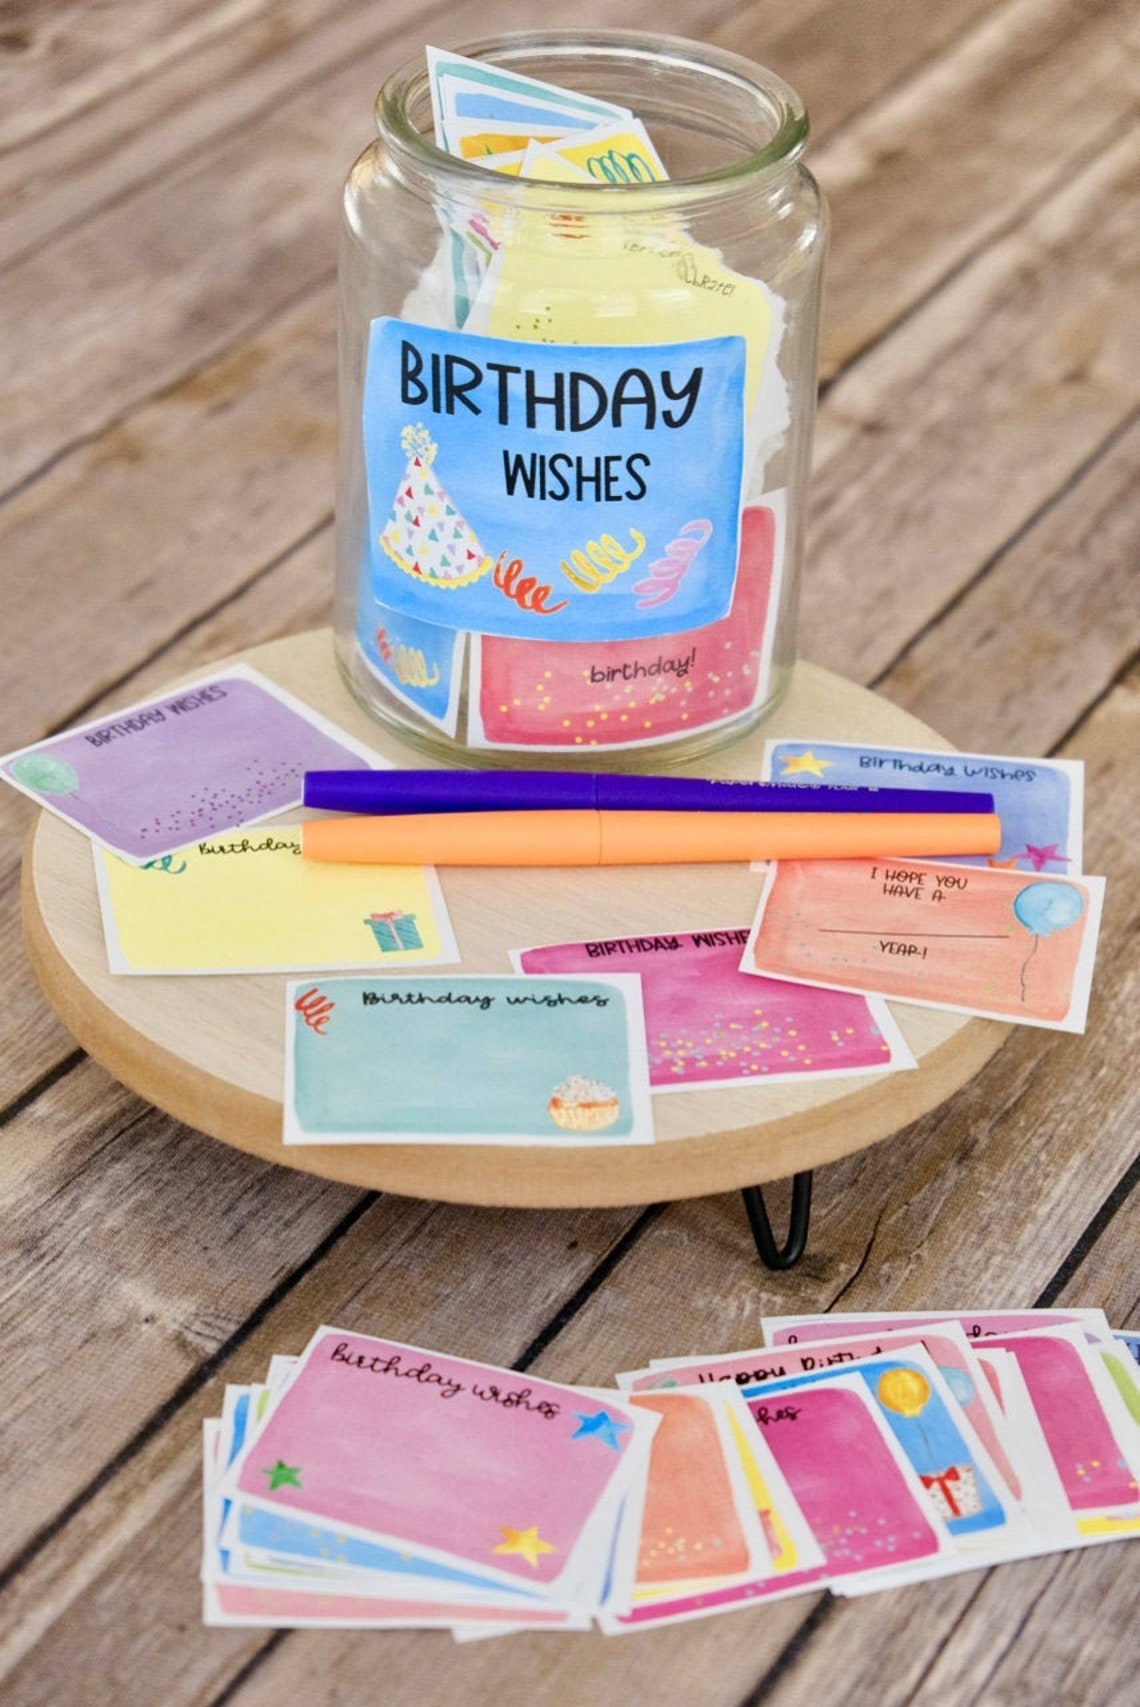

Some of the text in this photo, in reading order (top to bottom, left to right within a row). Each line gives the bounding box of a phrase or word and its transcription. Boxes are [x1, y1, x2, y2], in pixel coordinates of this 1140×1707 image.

[401, 339, 703, 432] BIRTHDAY
[502, 449, 651, 502] WISHES
[590, 646, 696, 683] birthday!
[84, 684, 228, 747] BIRTHDAY WISHES
[859, 755, 958, 777] Birthday
[198, 837, 302, 855] Birthday
[871, 866, 968, 890] I HOPE YOU
[883, 882, 946, 902] HAVE A
[584, 928, 752, 958] BIRTHDAY WISHE
[879, 939, 928, 960] YEAR!
[362, 990, 610, 1011] Birthday wishes
[330, 1342, 561, 1420] Birthday wishes
[756, 1406, 802, 1426] hes
